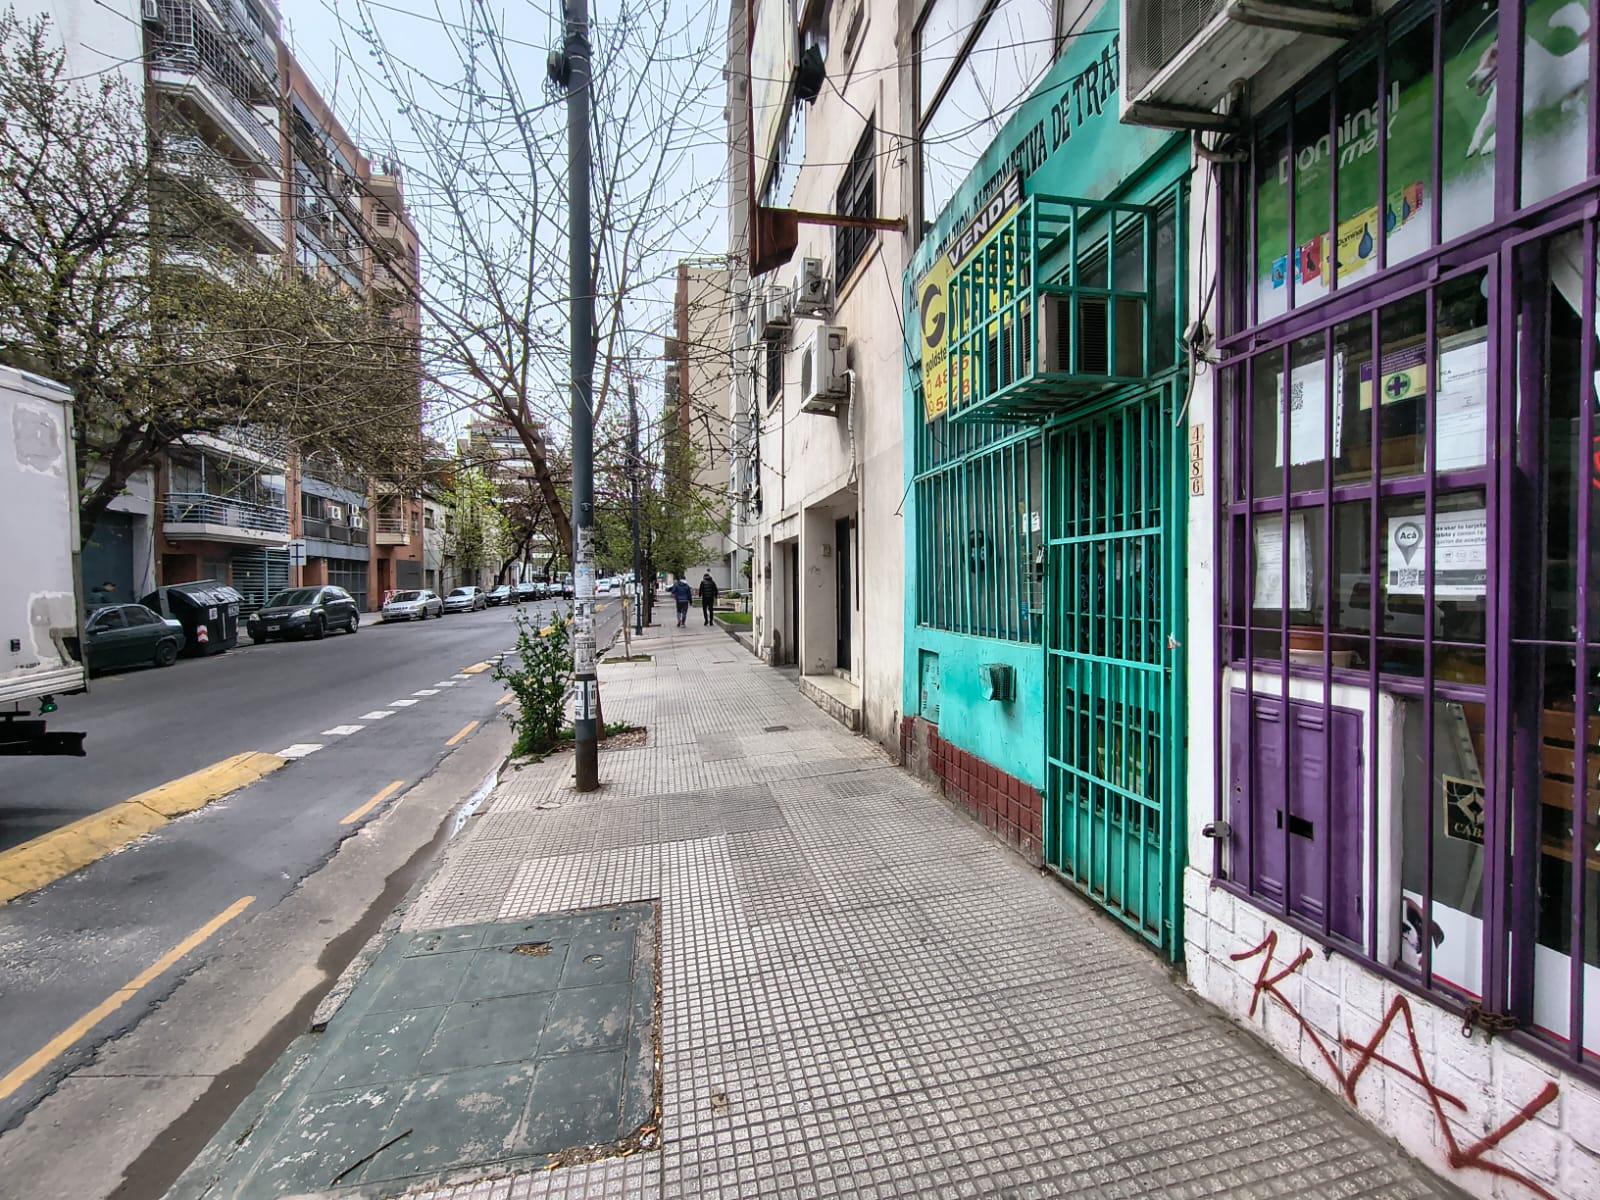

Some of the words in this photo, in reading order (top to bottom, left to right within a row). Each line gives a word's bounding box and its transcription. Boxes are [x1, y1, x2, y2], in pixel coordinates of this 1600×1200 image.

[1051, 89, 1071, 155] DE
[948, 174, 1019, 268] VENDE
[1400, 531, 1416, 540] Acá
[1454, 821, 1484, 838] CAB
